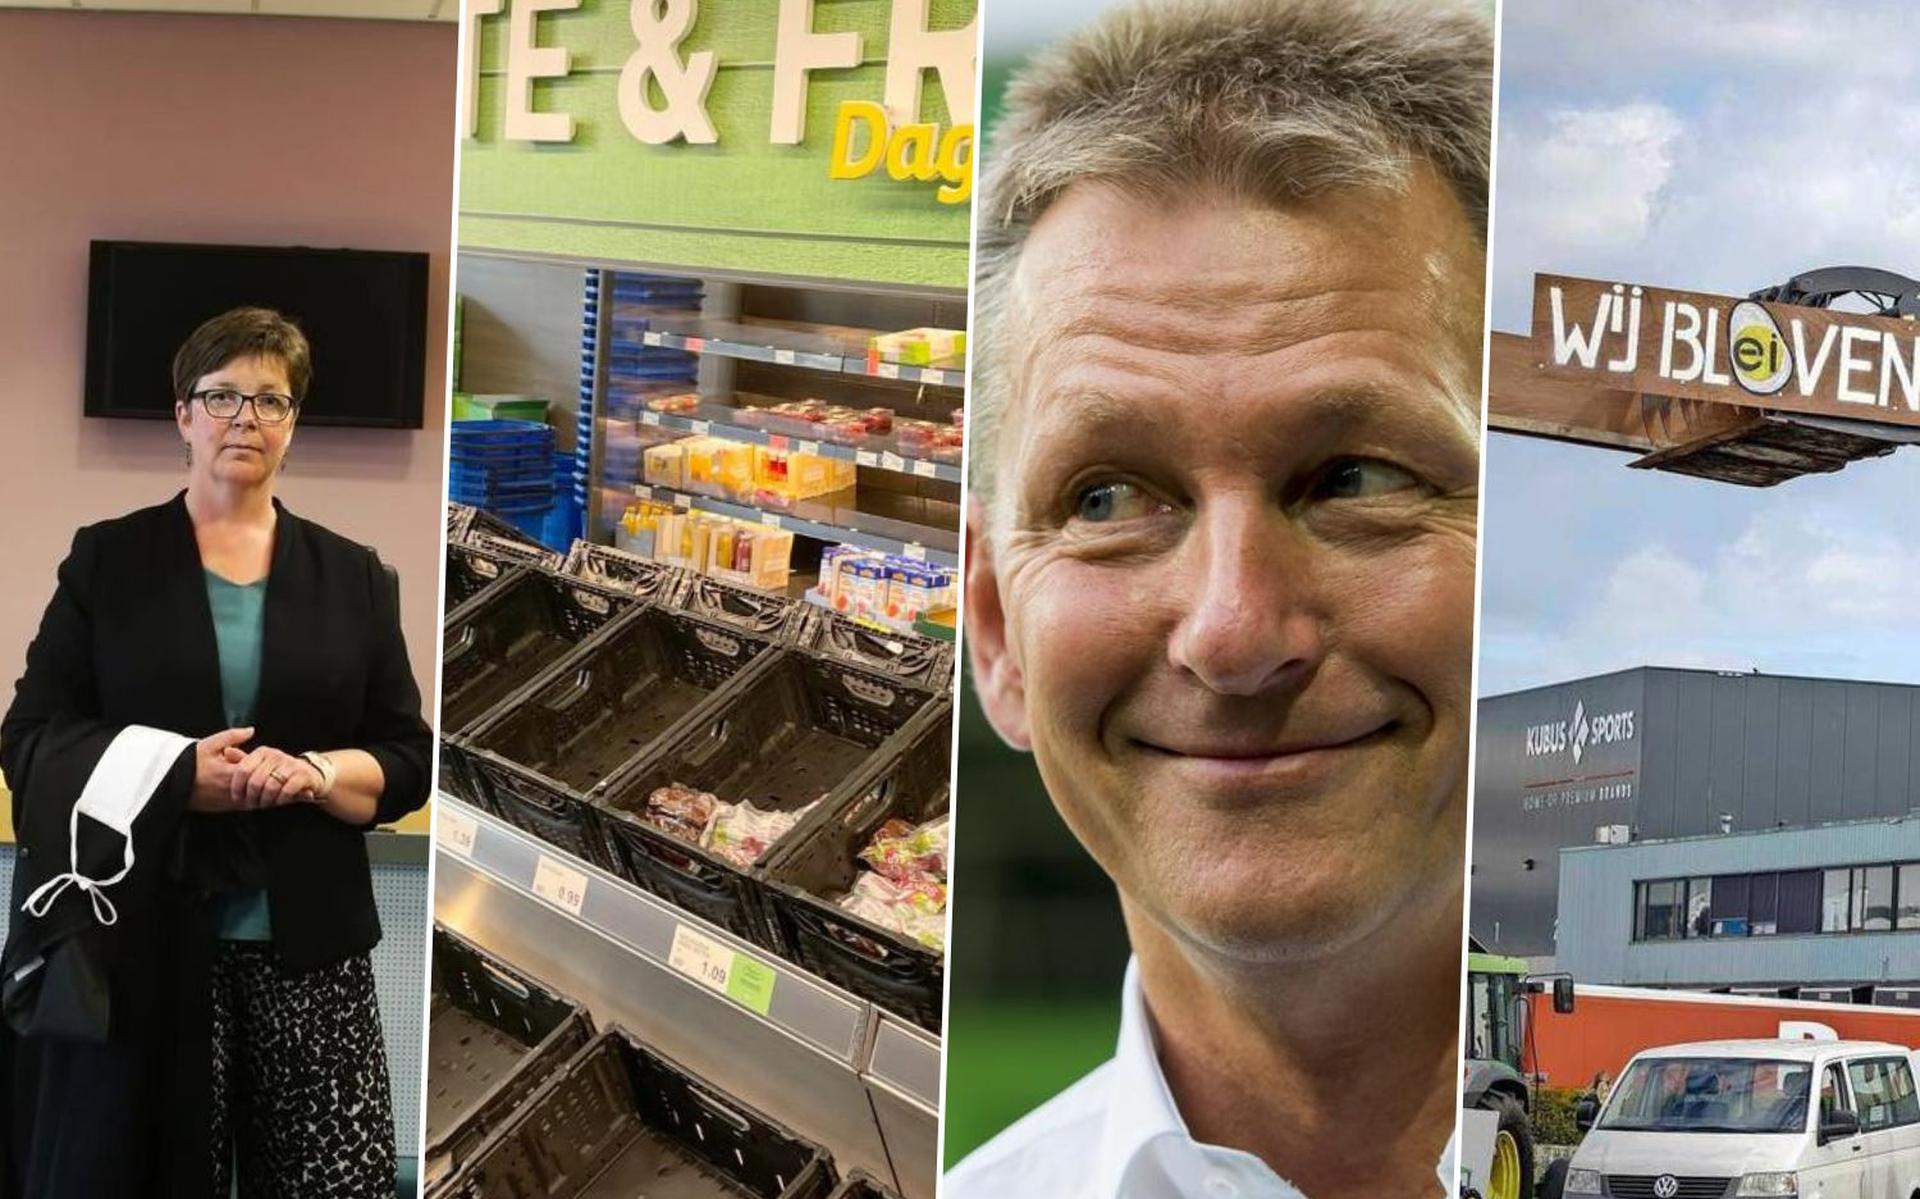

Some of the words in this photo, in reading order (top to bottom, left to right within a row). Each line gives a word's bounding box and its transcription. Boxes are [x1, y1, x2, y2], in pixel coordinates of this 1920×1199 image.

[617, 0, 718, 144] &
[828, 99, 976, 205] Dag
[1526, 720, 1567, 757] KUBUS
[1591, 710, 1635, 745] SPORTS
[702, 960, 726, 984] 1.09
